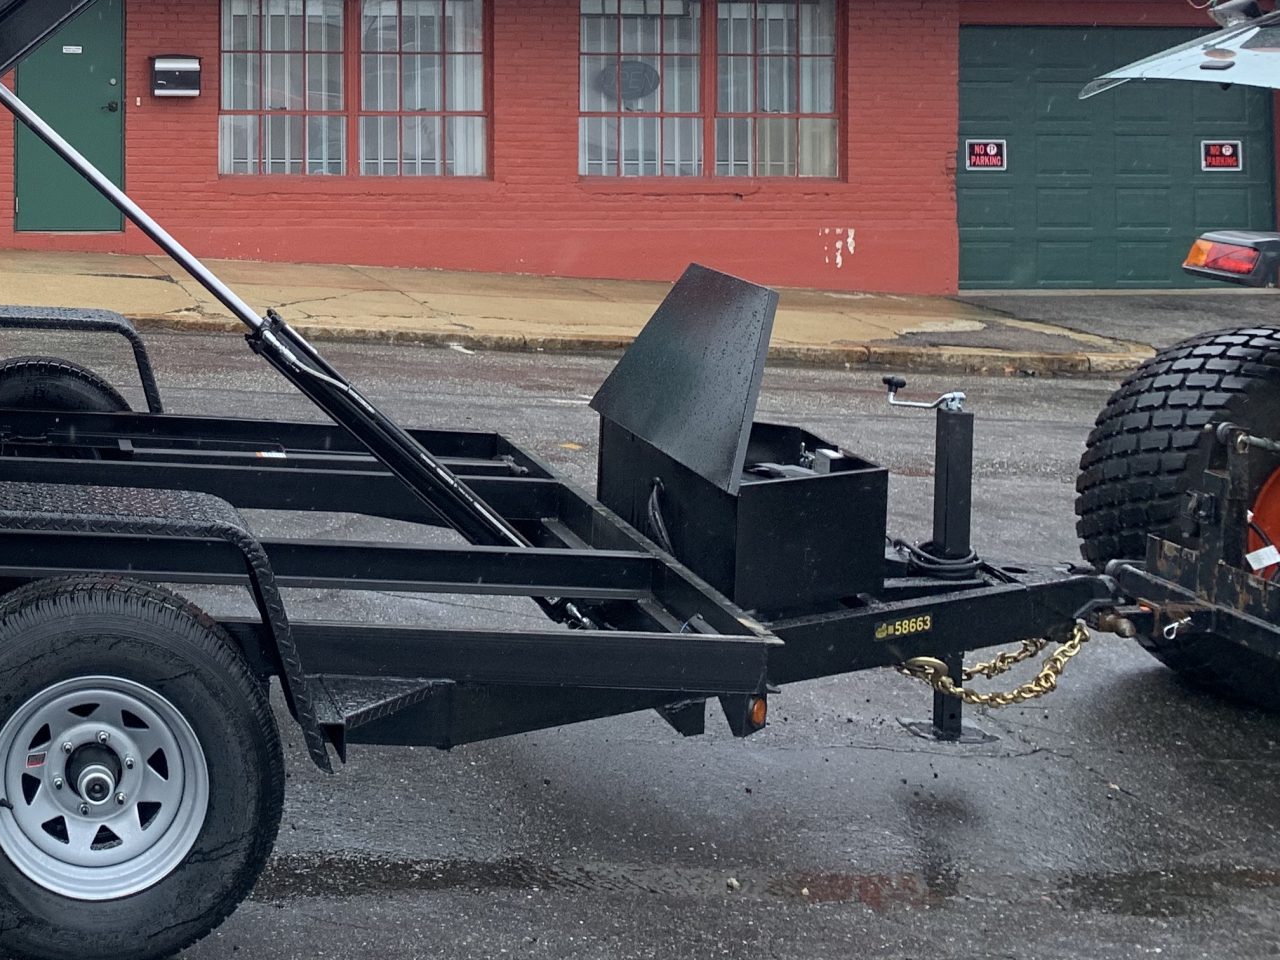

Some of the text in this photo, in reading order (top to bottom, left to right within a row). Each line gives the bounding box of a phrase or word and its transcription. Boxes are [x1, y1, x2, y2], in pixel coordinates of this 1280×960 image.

[974, 144, 985, 155] NO
[1209, 145, 1220, 155] NO
[970, 155, 1001, 166] PARKING
[1206, 156, 1237, 166] PARKING
[894, 615, 931, 636] 58663
